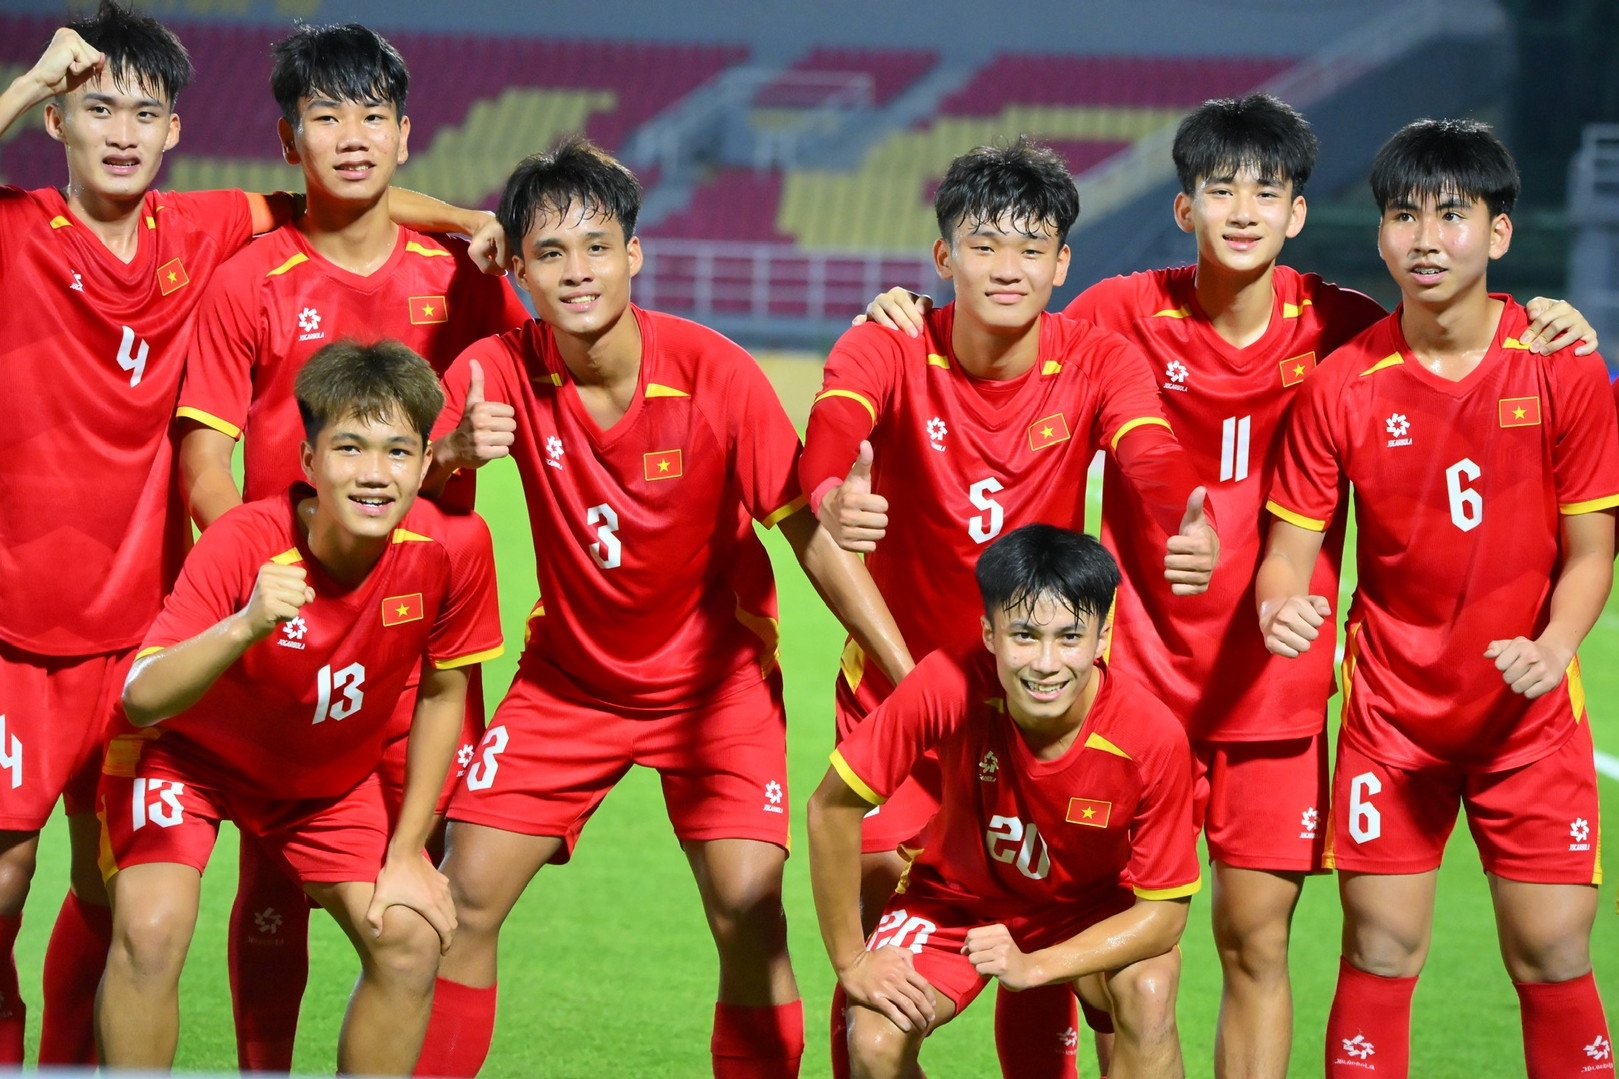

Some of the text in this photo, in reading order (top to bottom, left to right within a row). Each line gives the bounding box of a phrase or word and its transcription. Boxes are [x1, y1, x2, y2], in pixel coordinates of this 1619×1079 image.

[117, 326, 149, 387] 4
[1220, 415, 1250, 482] 11
[1446, 458, 1482, 532] 6
[587, 503, 621, 568] 3
[313, 662, 365, 724] 13
[466, 725, 509, 791] 3
[133, 778, 185, 831] 13
[1349, 772, 1381, 844] 6
[984, 815, 1050, 880] 20
[865, 910, 936, 955] 20
